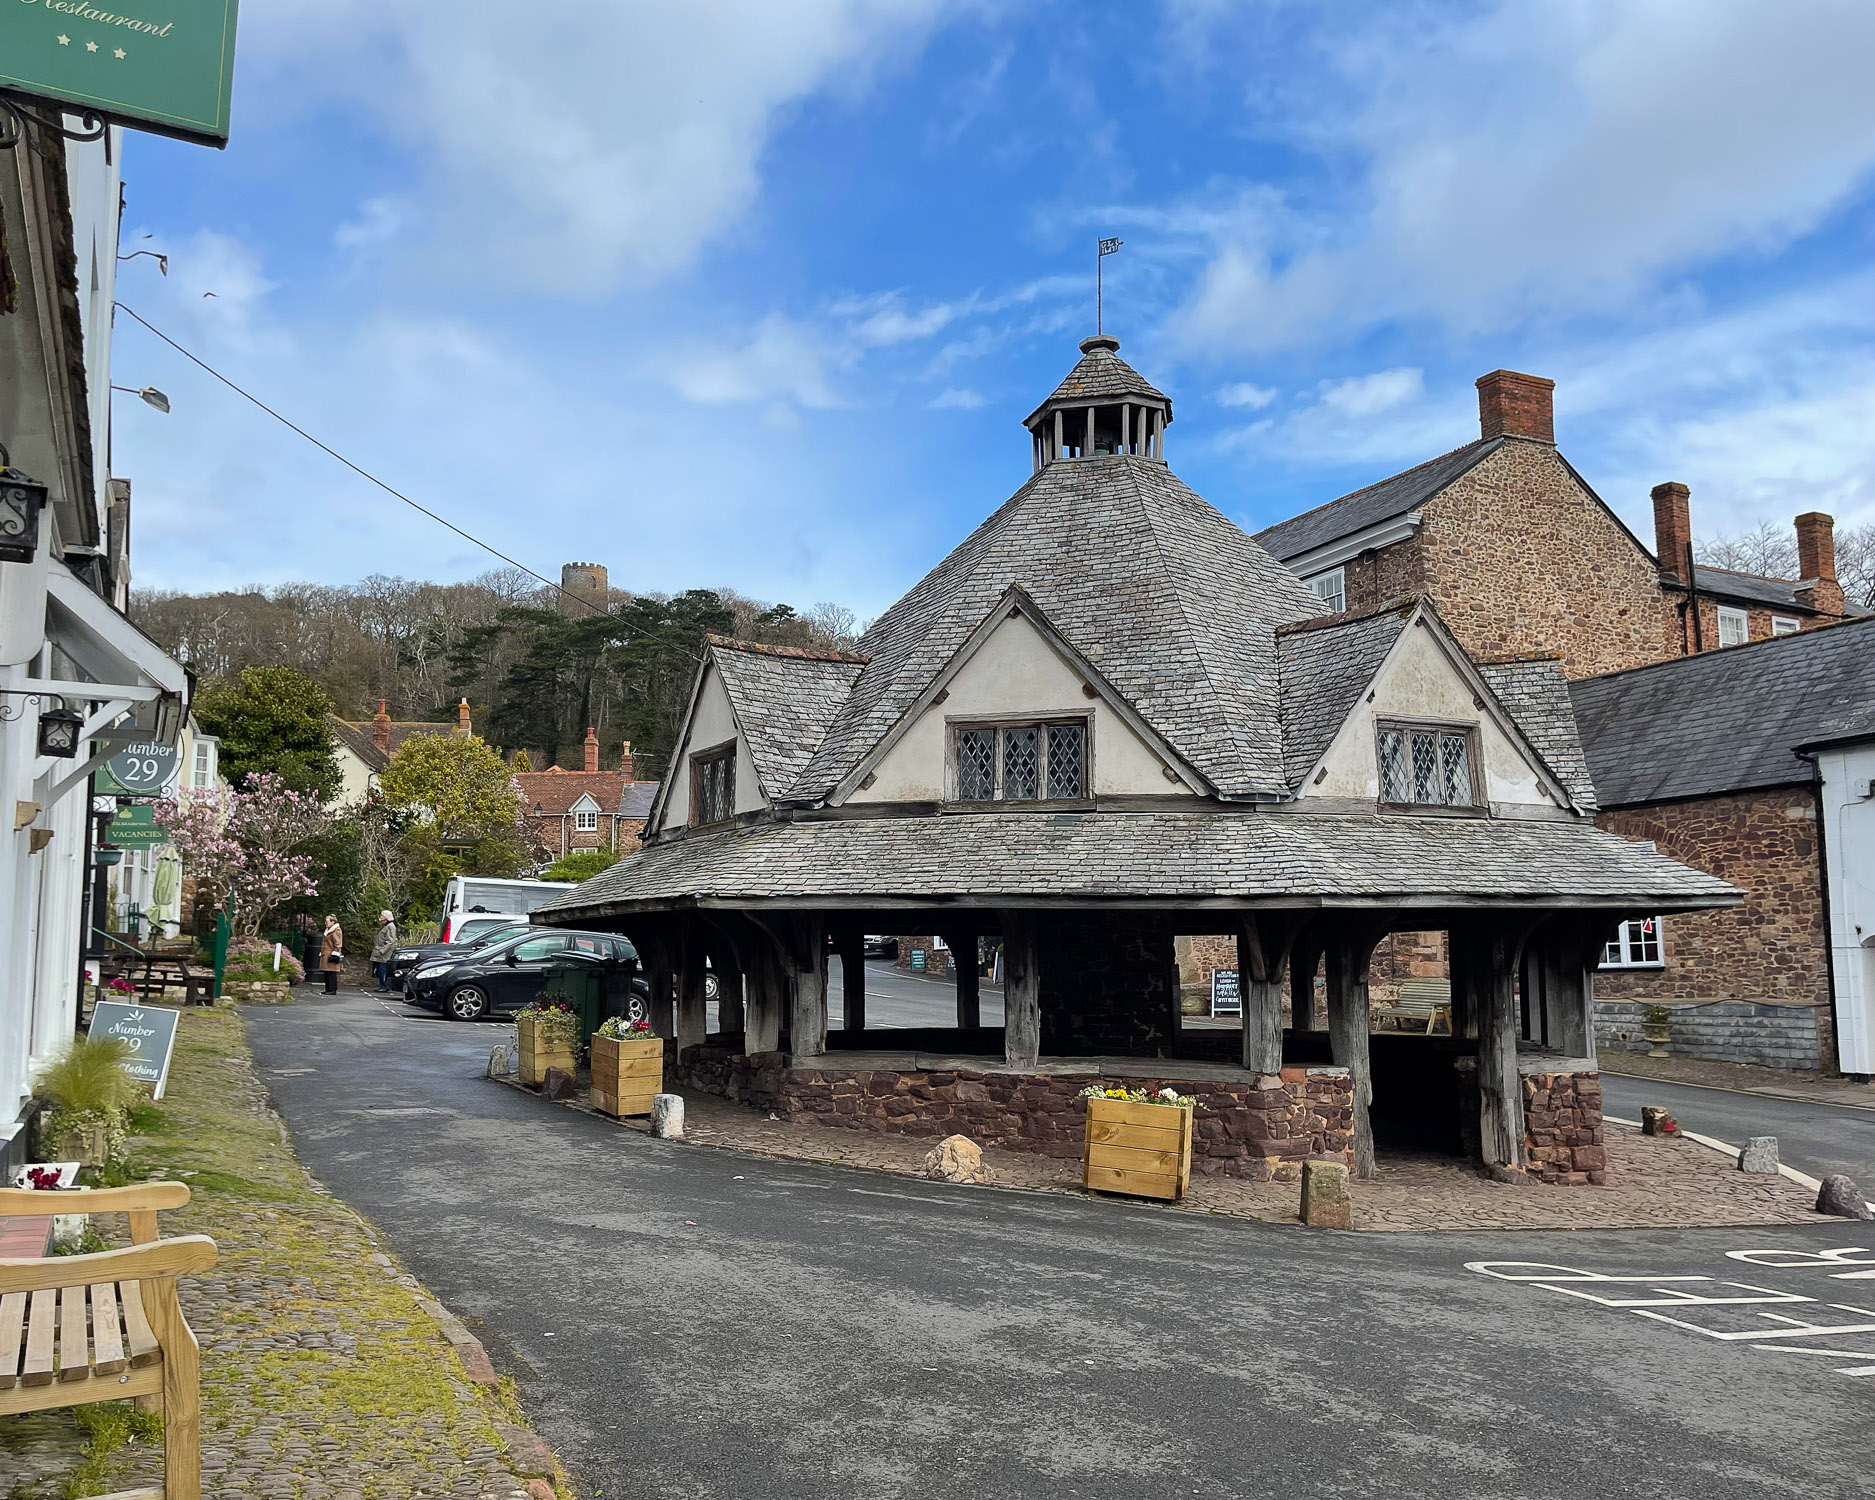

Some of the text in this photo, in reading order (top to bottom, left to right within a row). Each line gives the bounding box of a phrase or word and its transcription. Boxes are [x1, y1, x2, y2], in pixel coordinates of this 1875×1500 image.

[122, 740, 174, 757] umber
[124, 757, 159, 782] 29
[111, 830, 163, 838] VACANCIES
[108, 1022, 156, 1037] Number
